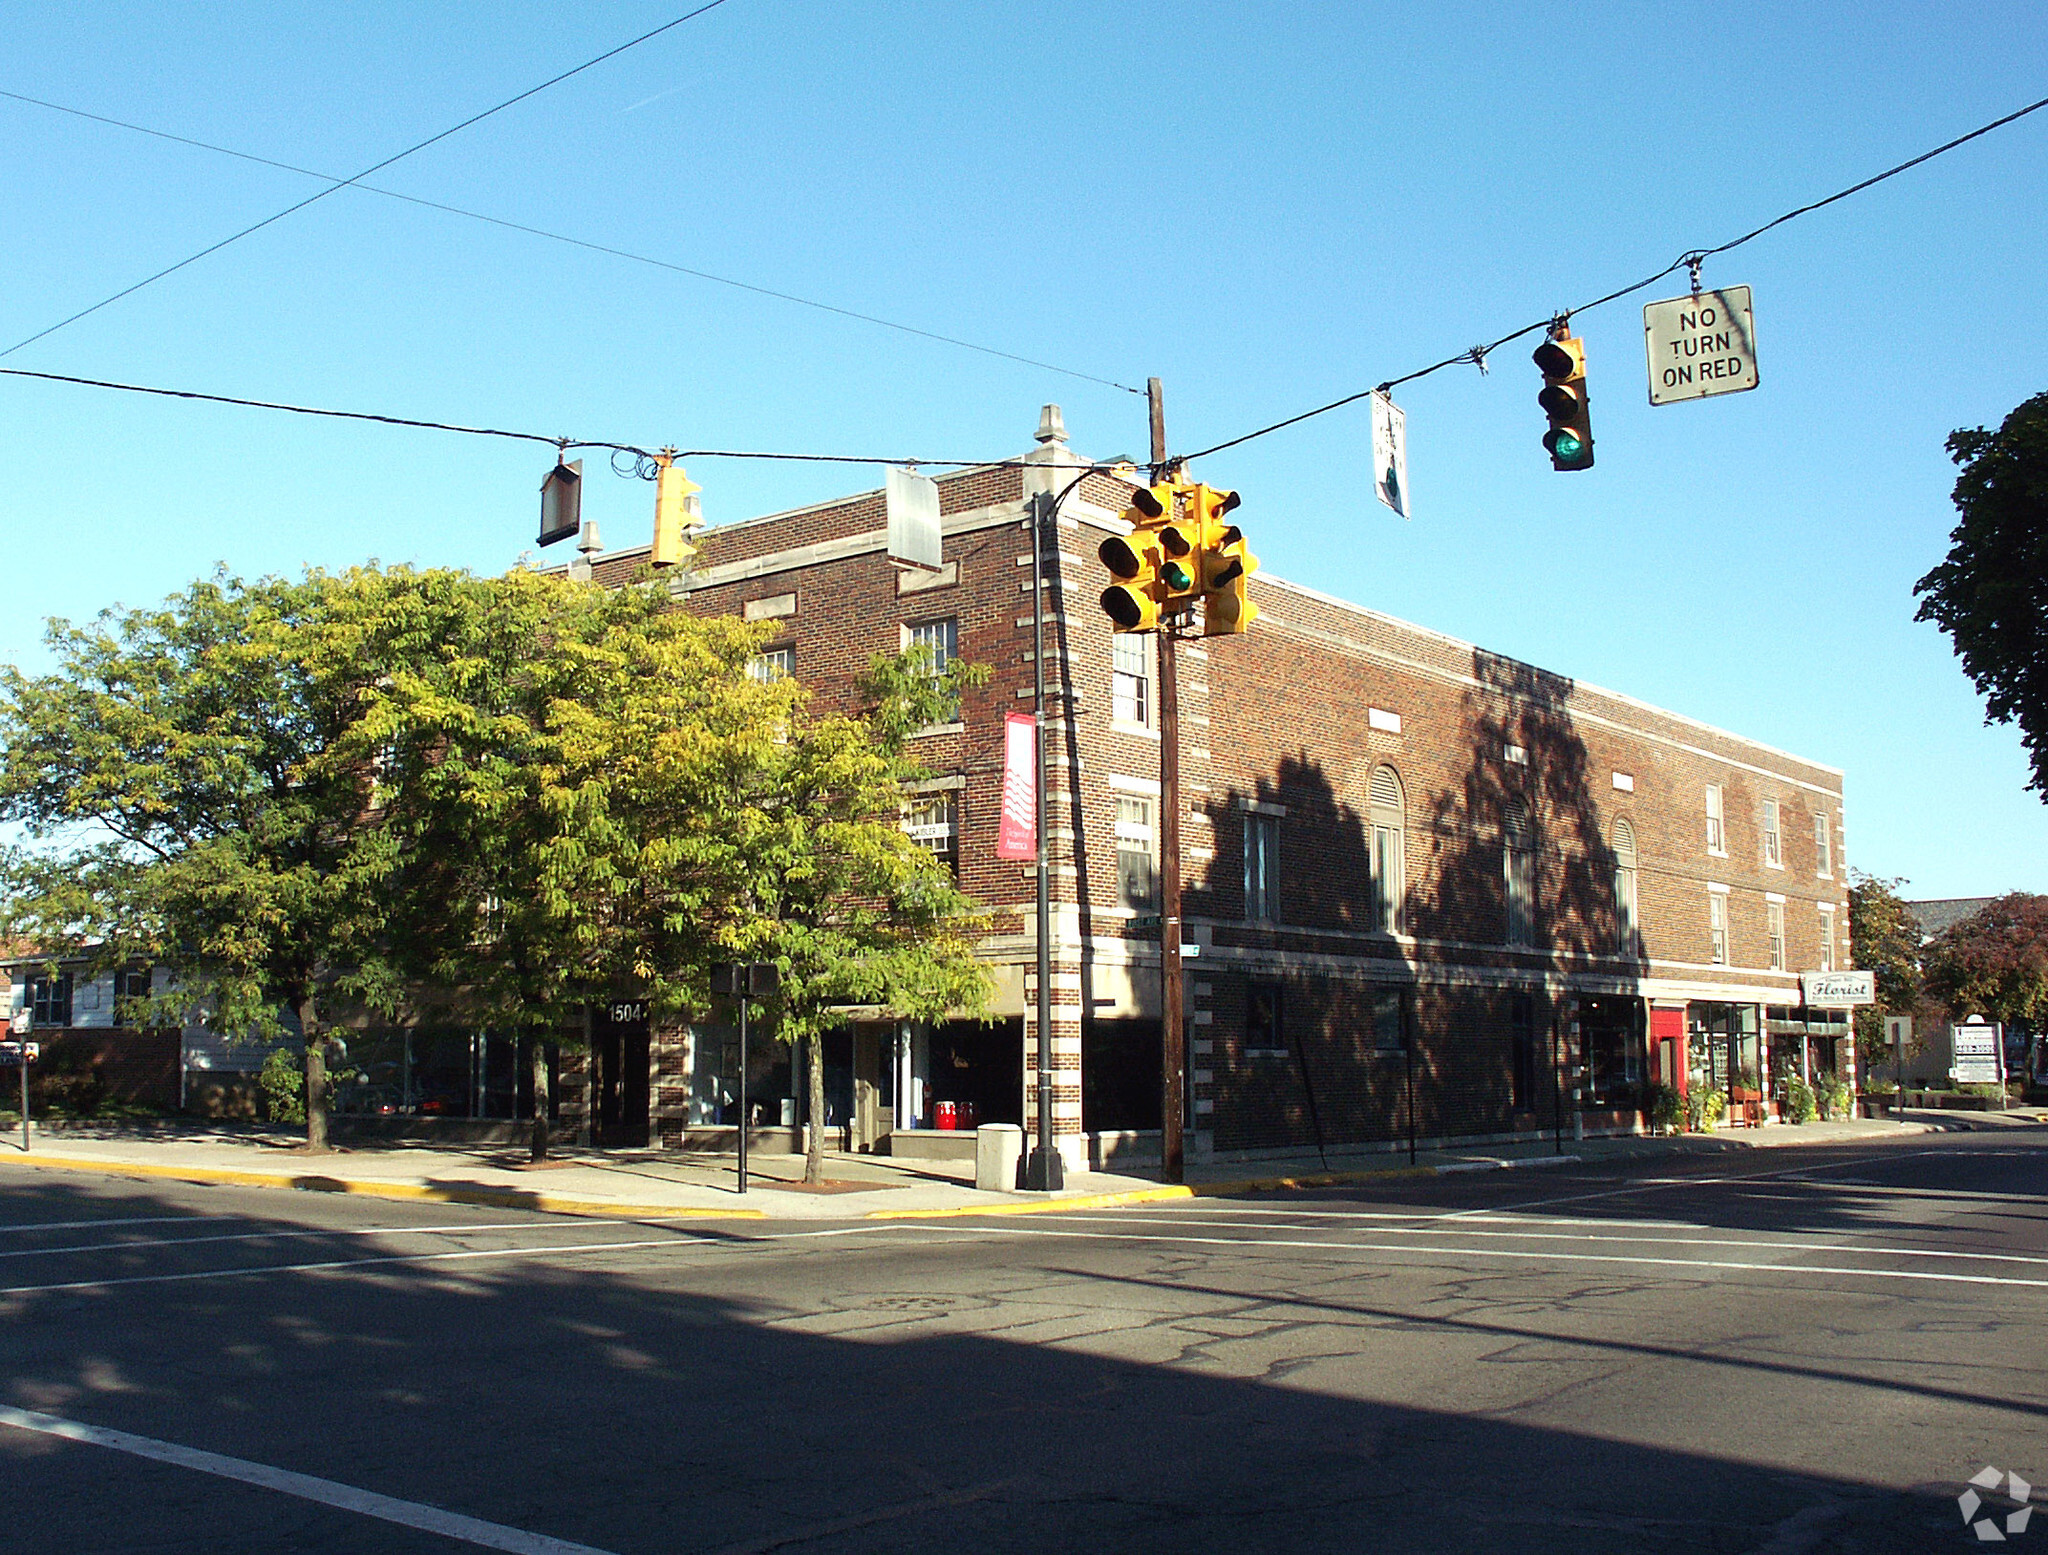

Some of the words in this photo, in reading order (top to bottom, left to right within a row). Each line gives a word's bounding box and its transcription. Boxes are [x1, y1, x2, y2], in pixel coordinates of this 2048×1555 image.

[1680, 308, 1716, 331] NO
[1670, 332, 1730, 357] TURN
[1663, 365, 1692, 387] ON
[1699, 357, 1742, 381] RED
[1812, 983, 1867, 995] Florist
[609, 1004, 640, 1022] 1504
